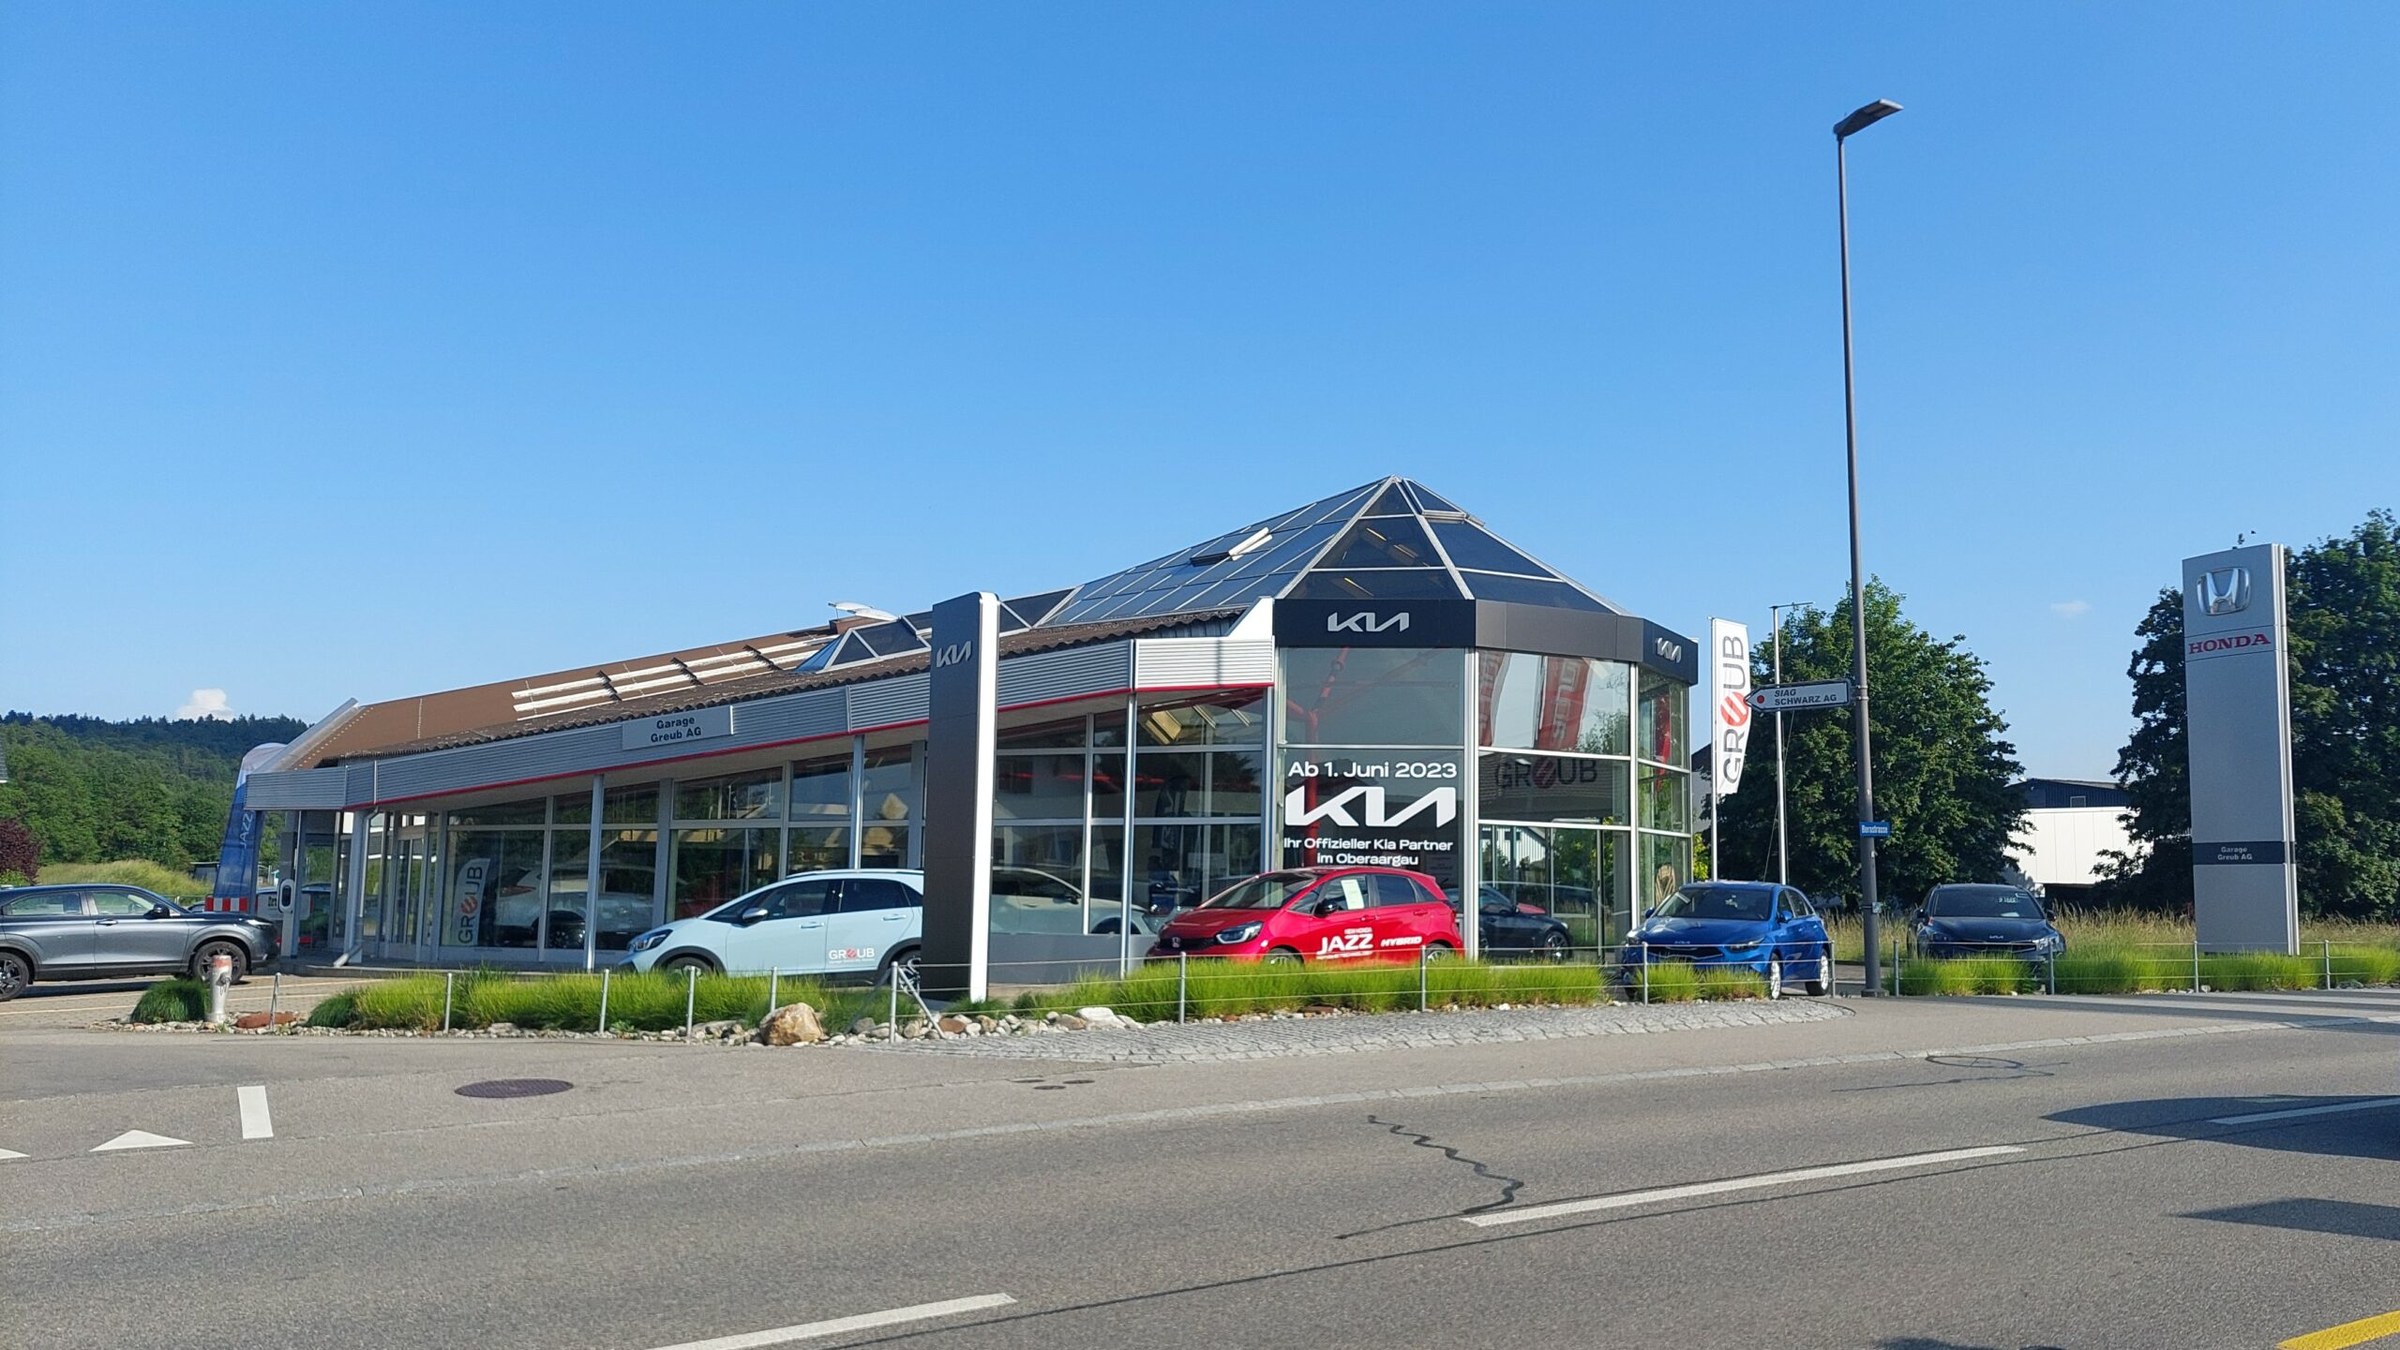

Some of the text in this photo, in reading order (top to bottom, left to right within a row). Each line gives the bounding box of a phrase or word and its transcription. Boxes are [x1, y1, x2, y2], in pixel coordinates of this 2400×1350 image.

[1327, 612, 1410, 632] KIA
[2188, 633, 2271, 655] HONDA
[1774, 688, 1797, 698] SIAG
[1774, 694, 1837, 706] SCHWARZ AG
[656, 717, 695, 730] Garage
[650, 726, 702, 743] Greub AG
[1288, 761, 1457, 778] Ab 1. Juni 2023
[1285, 785, 1457, 828] KIA
[1284, 838, 1453, 851] Ihr Offizieller Kia Partner
[2220, 846, 2248, 854] Garage
[1336, 853, 1418, 867] Oberaargau
[1316, 933, 1374, 956] JAZZ
[1380, 936, 1422, 948] HYBRID
